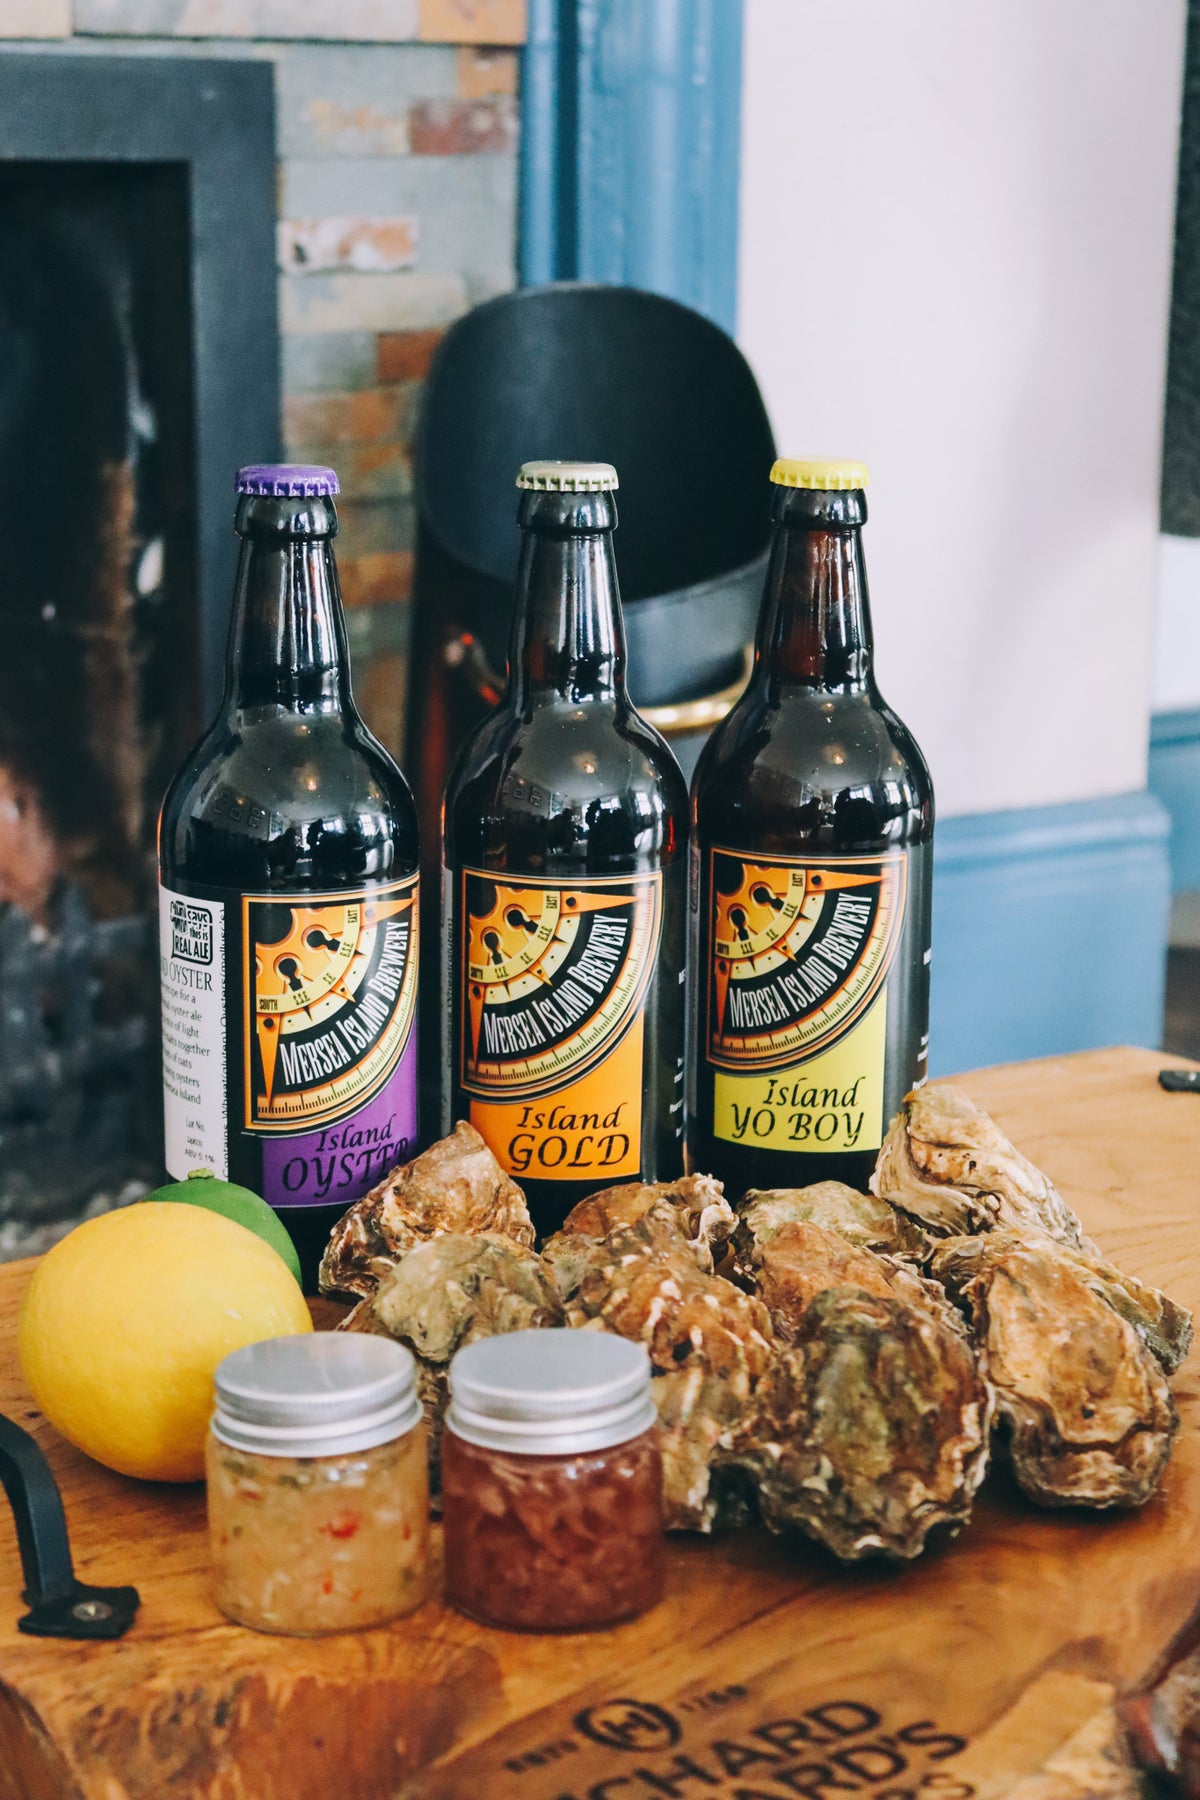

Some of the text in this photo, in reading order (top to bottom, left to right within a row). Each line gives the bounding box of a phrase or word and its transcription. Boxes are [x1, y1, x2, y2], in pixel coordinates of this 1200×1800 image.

[175, 935, 209, 959] REAL ALE
[729, 892, 872, 1028] MERSEA ISLAND BREWERY
[169, 962, 213, 991] OYSTER
[483, 1009, 546, 1054] MERSEA
[532, 979, 594, 1038] ISLAND
[566, 913, 628, 994] BREWERY
[191, 996, 196, 1004] a
[259, 999, 278, 1011] SOUTH
[279, 921, 409, 1086] MERSEA ISLAND BREWERY
[182, 1023, 199, 1038] light
[190, 1010, 202, 1022] ale
[177, 1040, 211, 1056] together
[178, 1057, 193, 1069] oats
[175, 1071, 200, 1088] oysters
[763, 1076, 866, 1108] Island
[180, 1088, 201, 1105] Island
[516, 1101, 629, 1131] Island
[731, 1103, 865, 1148] YO BOY
[315, 1113, 397, 1152] Island
[508, 1133, 630, 1172] GOLD
[555, 1701, 882, 1800] CHARD
